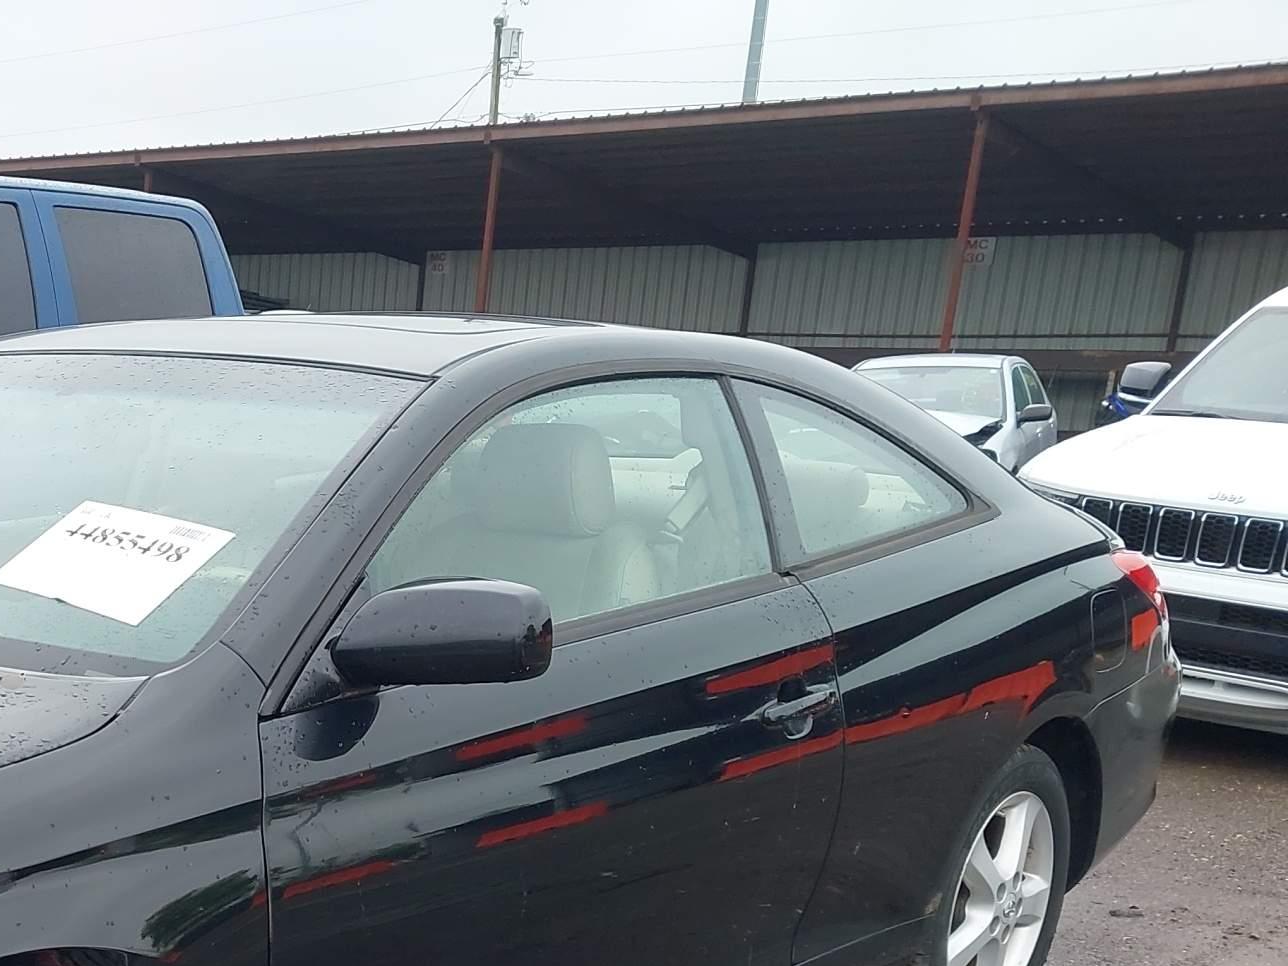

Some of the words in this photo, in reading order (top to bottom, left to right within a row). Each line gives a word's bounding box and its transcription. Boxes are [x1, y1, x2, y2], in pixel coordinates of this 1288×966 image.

[967, 239, 989, 250] MC
[430, 252, 447, 262] MC
[1207, 489, 1247, 505] Jeep
[65, 522, 190, 563] 44855498
